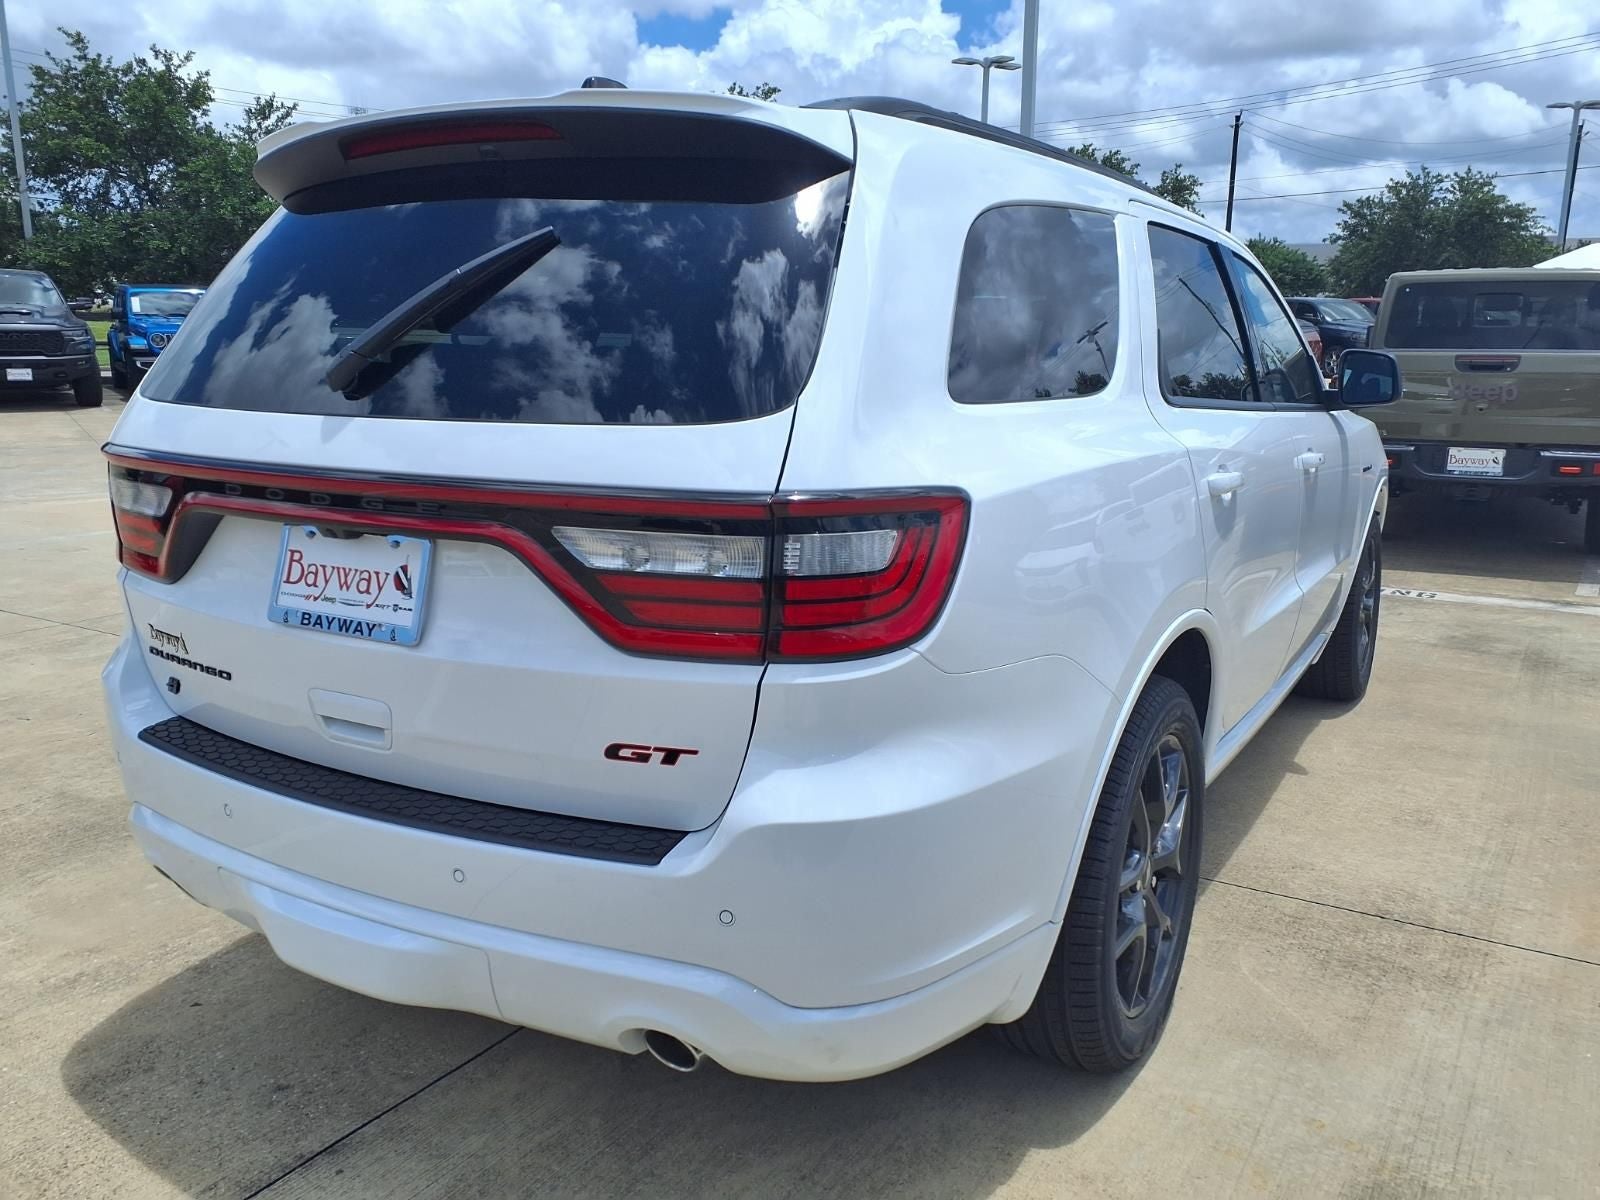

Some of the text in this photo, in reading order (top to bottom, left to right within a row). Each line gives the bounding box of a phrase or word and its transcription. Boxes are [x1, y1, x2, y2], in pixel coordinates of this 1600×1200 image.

[1449, 454, 1491, 468] Bayway
[224, 482, 441, 515] DODGE
[282, 548, 391, 609] Bayway
[300, 611, 377, 638] BAYWAY
[148, 645, 232, 681] DURANGO
[603, 742, 700, 767] GT
